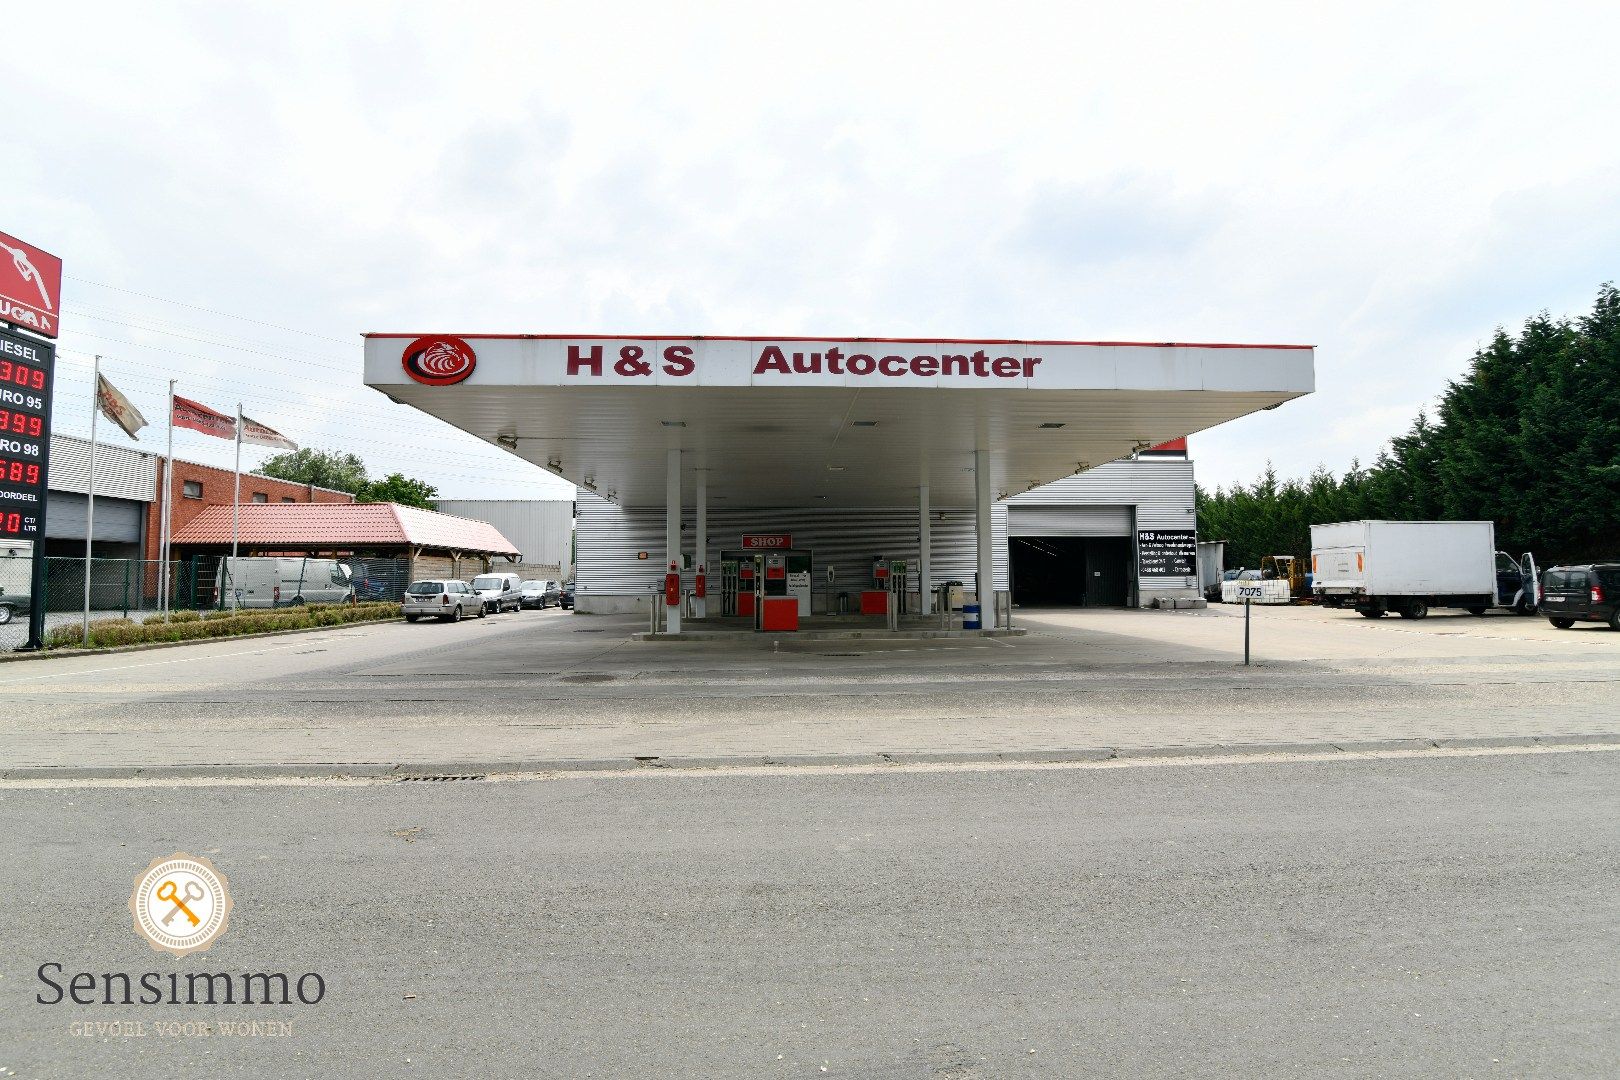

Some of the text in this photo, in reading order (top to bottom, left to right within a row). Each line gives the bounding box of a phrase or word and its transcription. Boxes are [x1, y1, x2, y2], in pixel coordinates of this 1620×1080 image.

[752, 345, 1042, 379] Autocenter
[26, 395, 42, 409] 95
[23, 443, 39, 456] 98
[24, 524, 37, 532] LTR
[750, 537, 784, 547] SHOP
[1156, 533, 1189, 541] Autocenter
[1239, 586, 1262, 597] 7075
